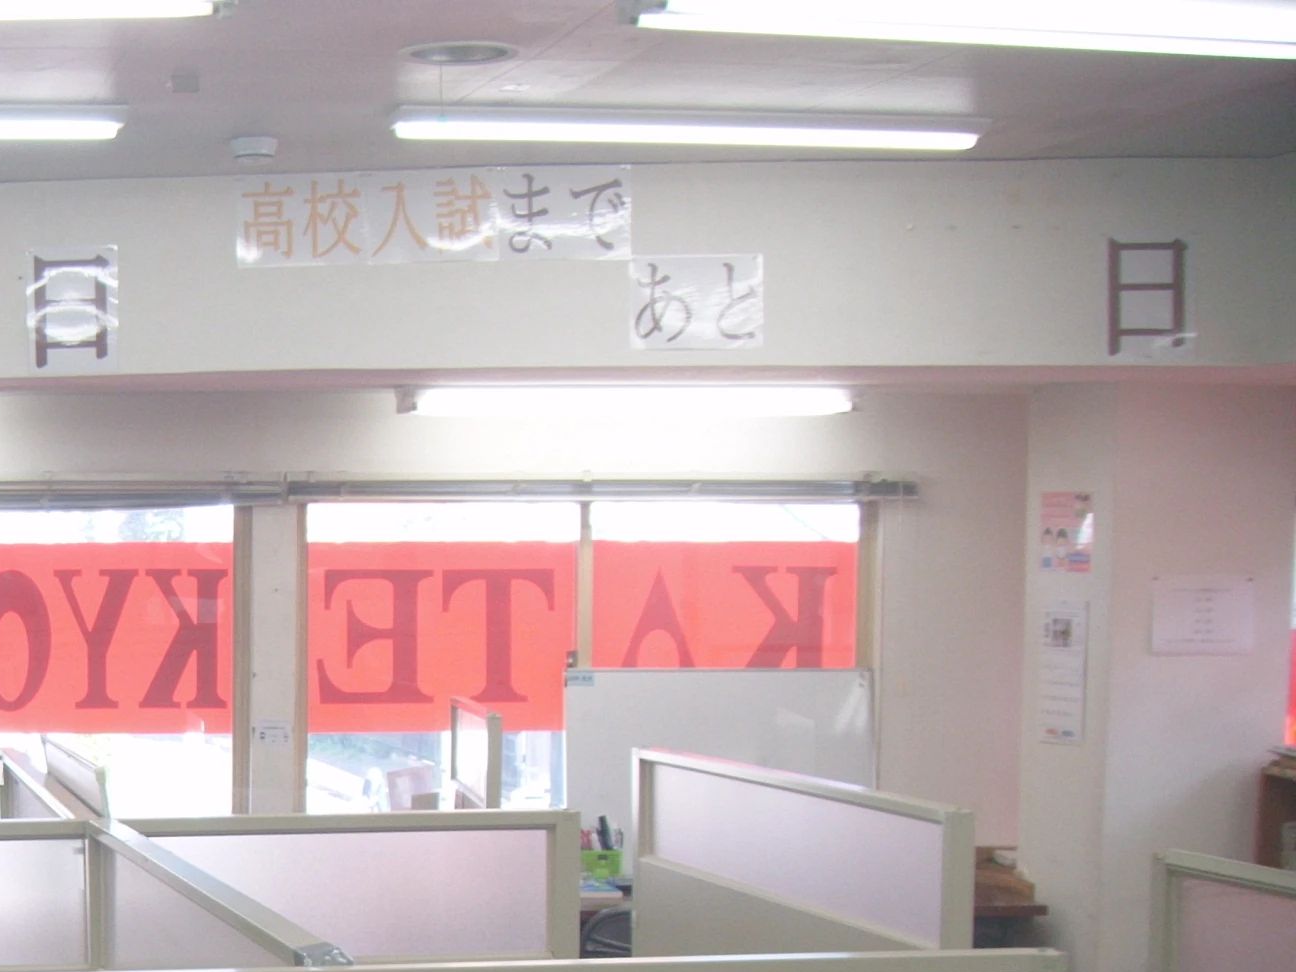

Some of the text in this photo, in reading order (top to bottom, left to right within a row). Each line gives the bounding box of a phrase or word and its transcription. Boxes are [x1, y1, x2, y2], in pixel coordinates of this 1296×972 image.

[242, 173, 625, 259] 高校入試まで
[33, 254, 111, 368] 日
[634, 237, 1187, 355] あと 日
